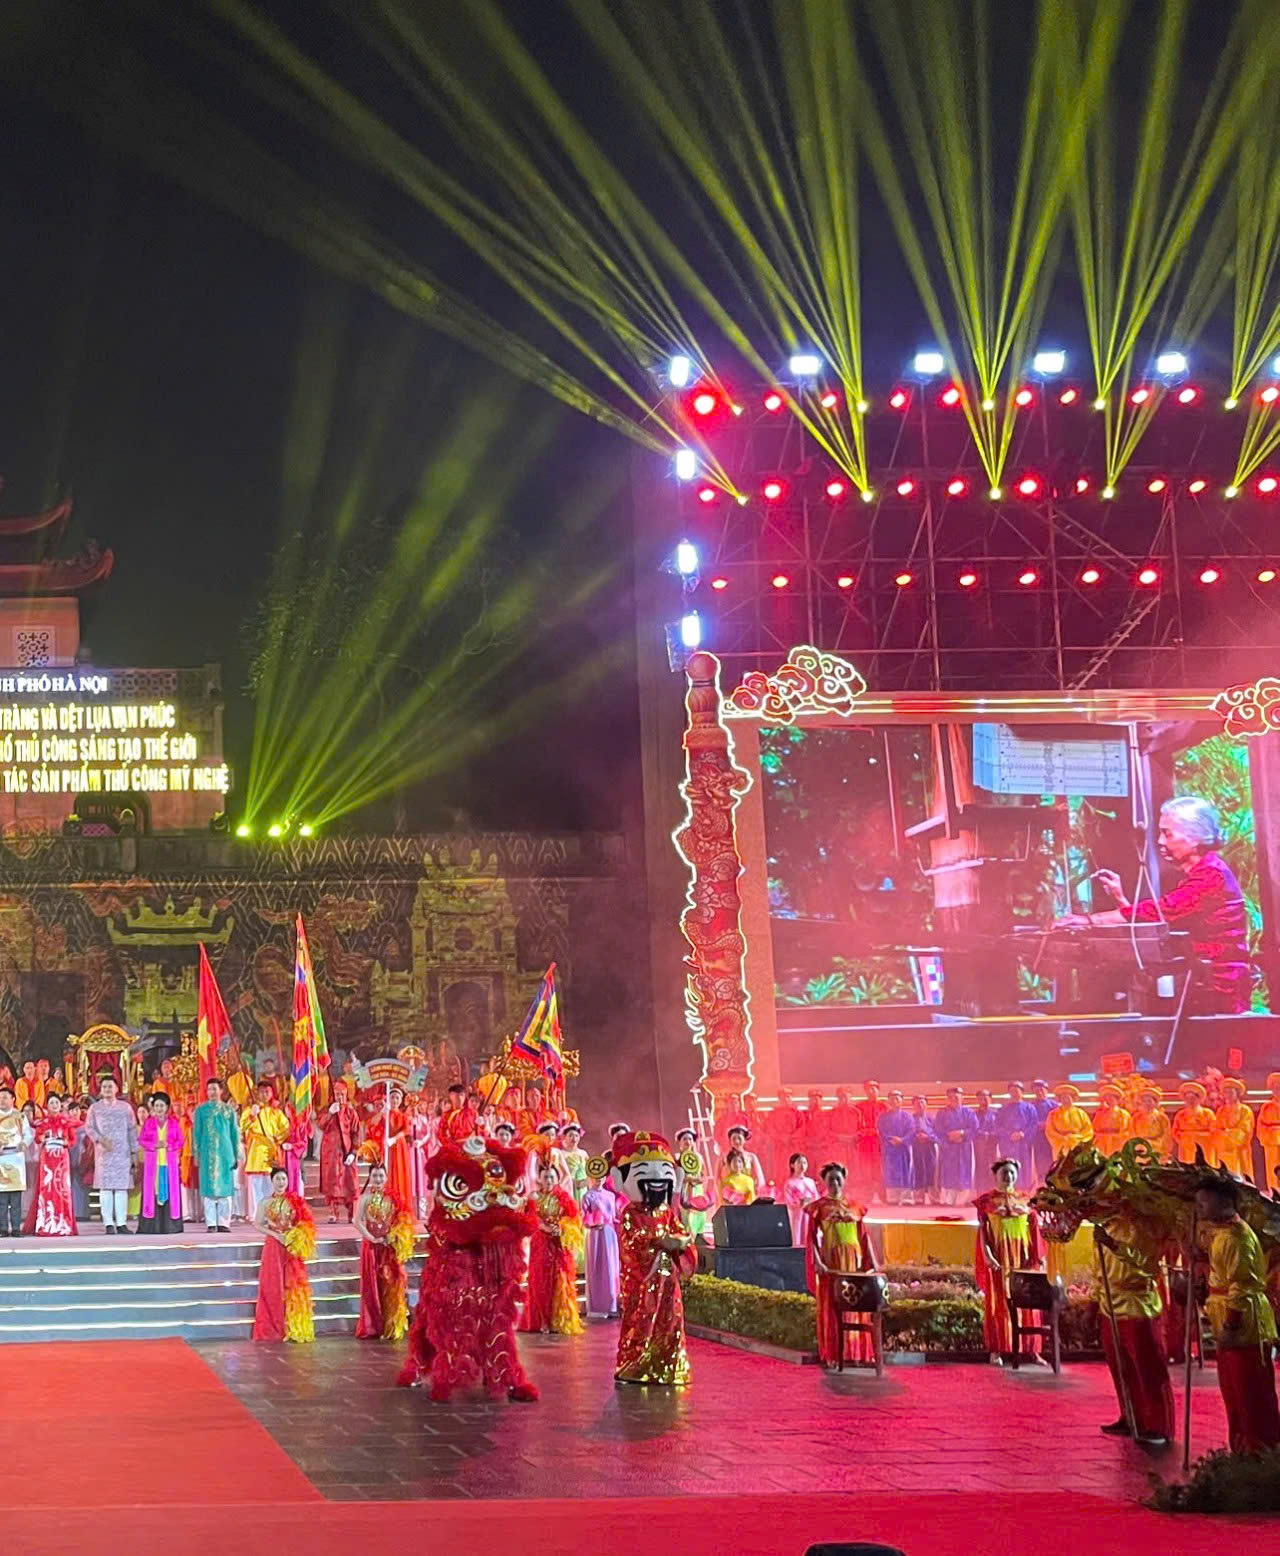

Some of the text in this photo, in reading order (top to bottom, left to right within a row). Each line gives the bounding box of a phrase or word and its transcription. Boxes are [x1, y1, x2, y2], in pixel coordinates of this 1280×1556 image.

[52, 673, 77, 692] HÀ
[79, 675, 108, 694] NỘI
[41, 702, 58, 730] VÀ
[59, 702, 84, 733] DỆT
[86, 706, 111, 733] LỤA
[140, 700, 176, 729] PHÚC
[41, 735, 78, 762] CÔNG
[79, 734, 117, 761] SÁNG
[117, 737, 142, 764] TẠO
[144, 731, 169, 760] THẾ
[3, 765, 28, 793] TÁC
[31, 762, 61, 793] SẢN
[130, 764, 168, 792] CÔNG
